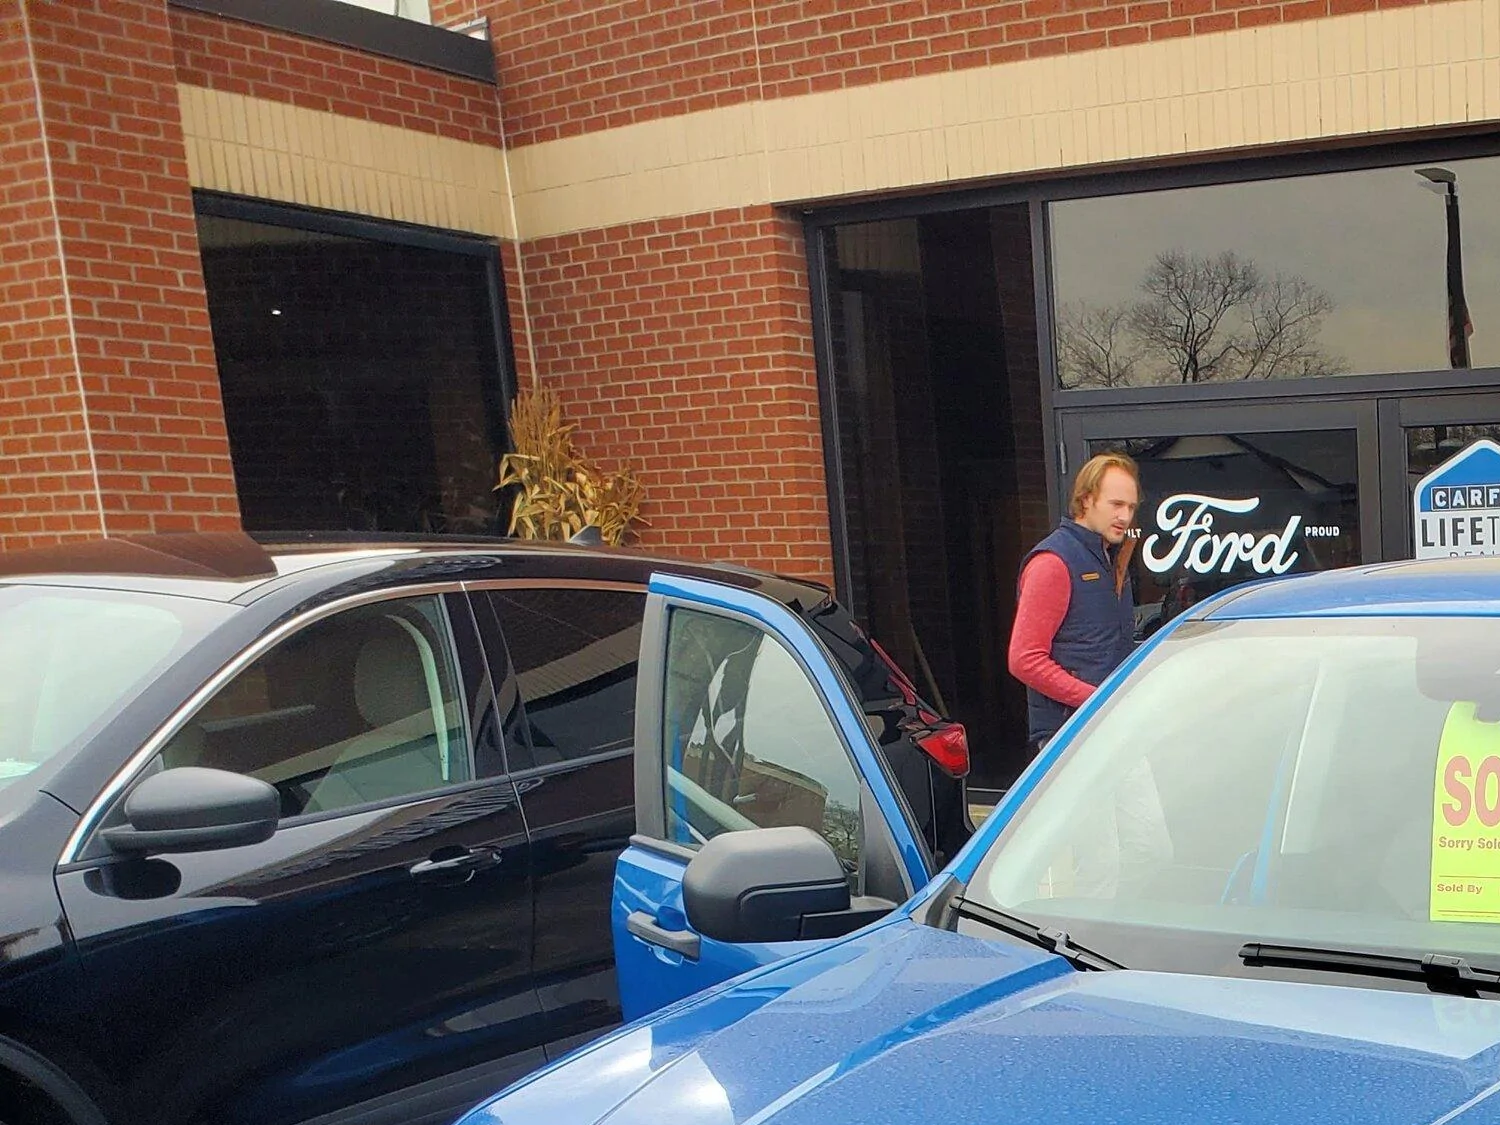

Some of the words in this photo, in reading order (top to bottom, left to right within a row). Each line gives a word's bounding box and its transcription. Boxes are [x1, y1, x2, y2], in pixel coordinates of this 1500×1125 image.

[1142, 493, 1302, 574] Ford
[1305, 526, 1340, 538] PROUD
[1438, 836, 1474, 851] Sorry
[1437, 883, 1464, 893] Sold
[1467, 884, 1483, 895] By
